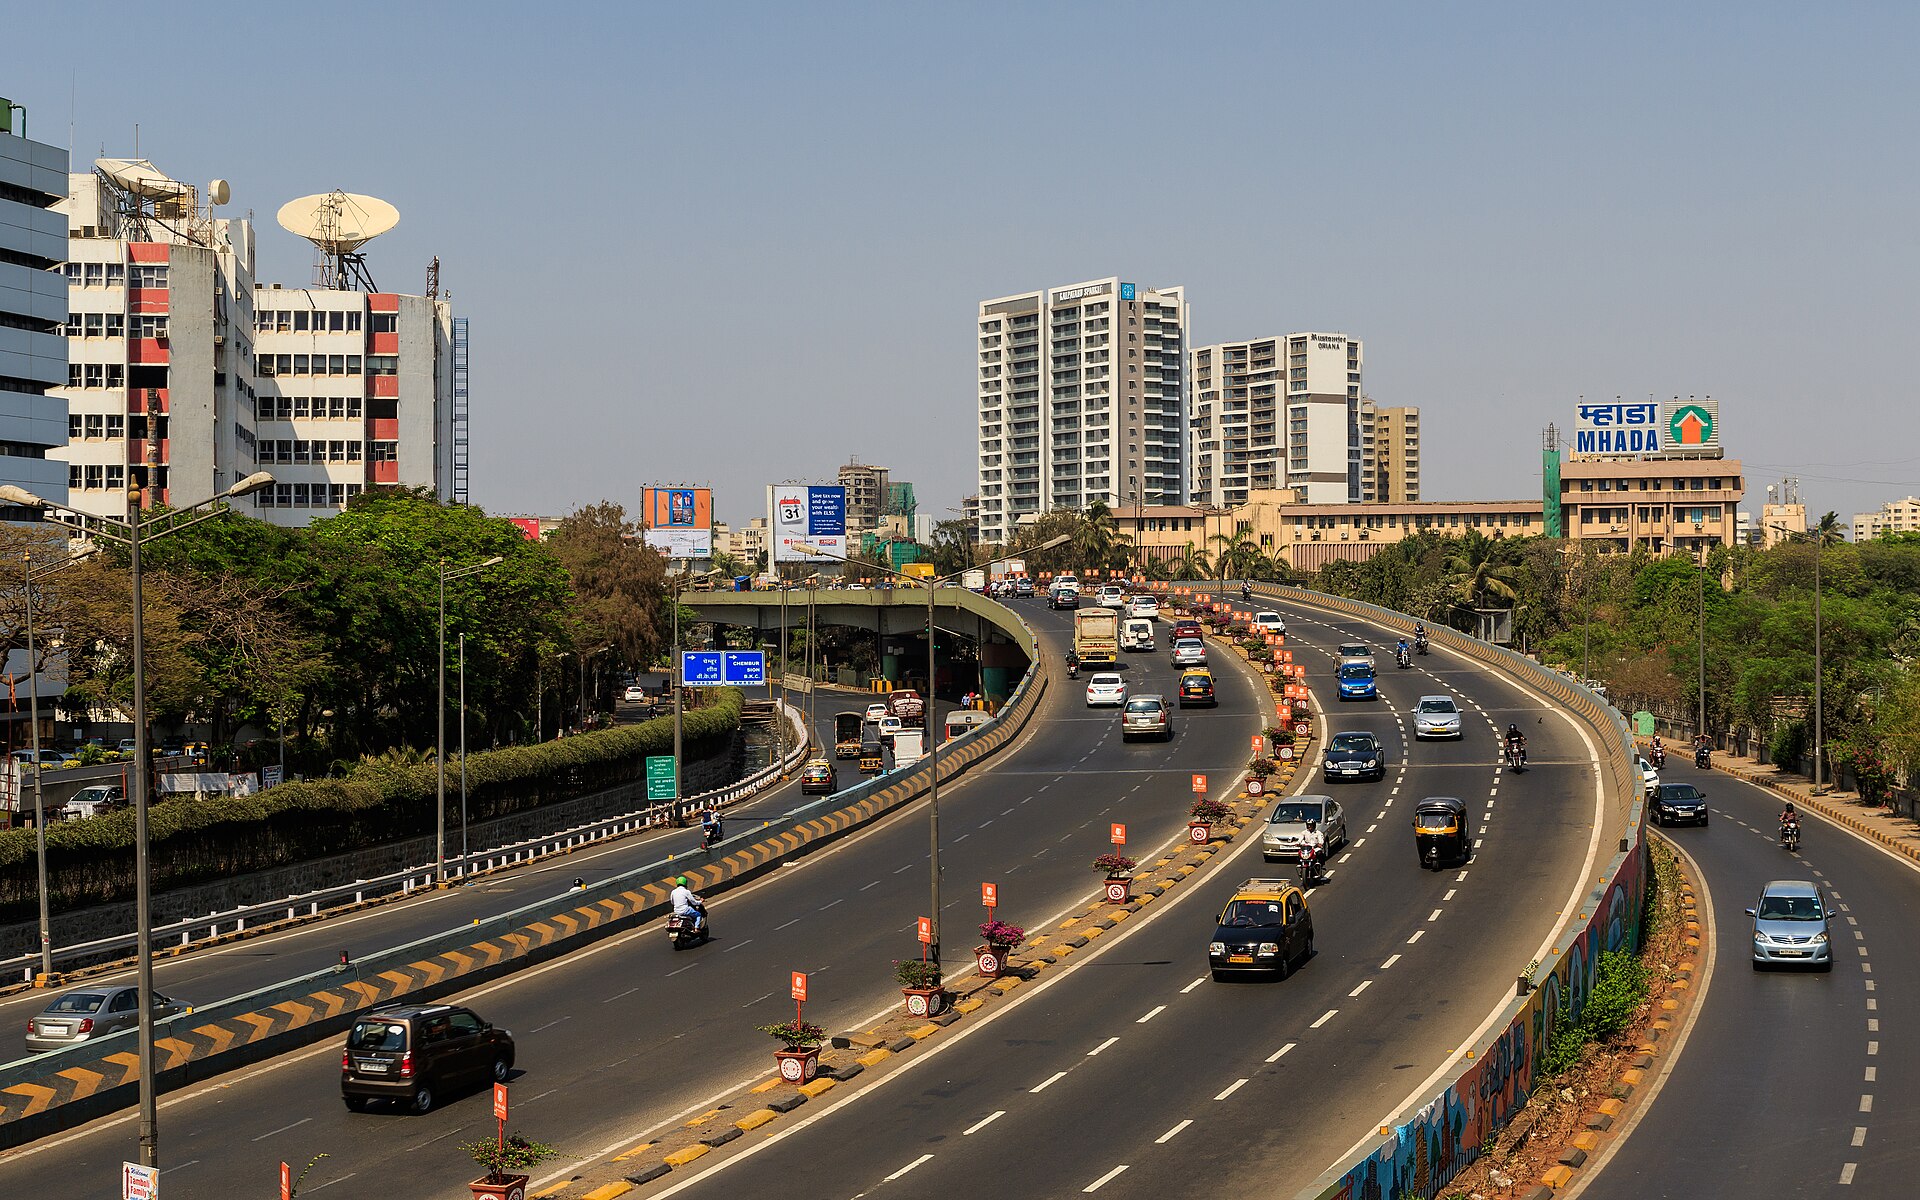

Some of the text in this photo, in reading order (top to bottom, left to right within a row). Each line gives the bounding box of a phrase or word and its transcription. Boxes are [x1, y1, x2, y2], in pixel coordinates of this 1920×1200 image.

[1578, 404, 1658, 426] म्हाडा
[1577, 430, 1658, 452] MHADA
[785, 508, 800, 519] 31
[130, 1186, 147, 1198] Family
